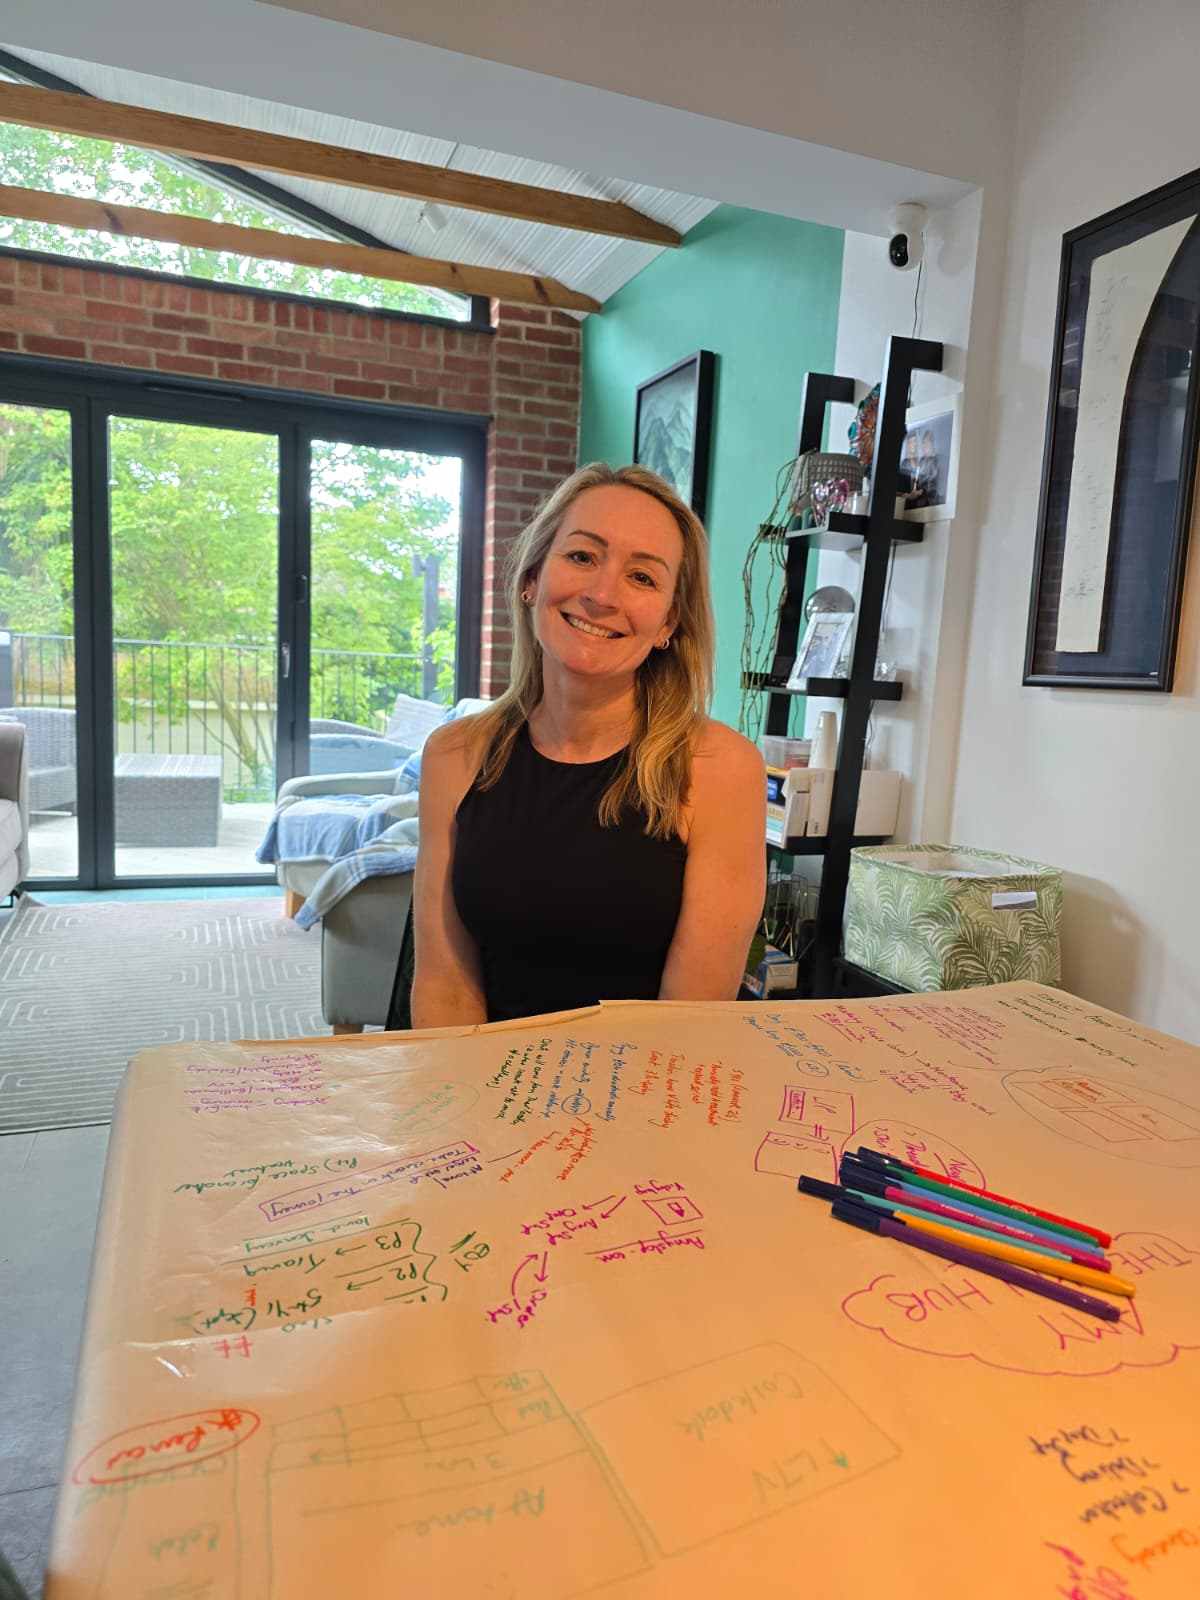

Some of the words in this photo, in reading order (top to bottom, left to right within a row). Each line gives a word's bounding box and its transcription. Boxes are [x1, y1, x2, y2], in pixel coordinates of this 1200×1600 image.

[374, 1230, 402, 1251] P3
[395, 1262, 417, 1281] P2
[1106, 1243, 1192, 1275] THE
[886, 1279, 991, 1321] HUB
